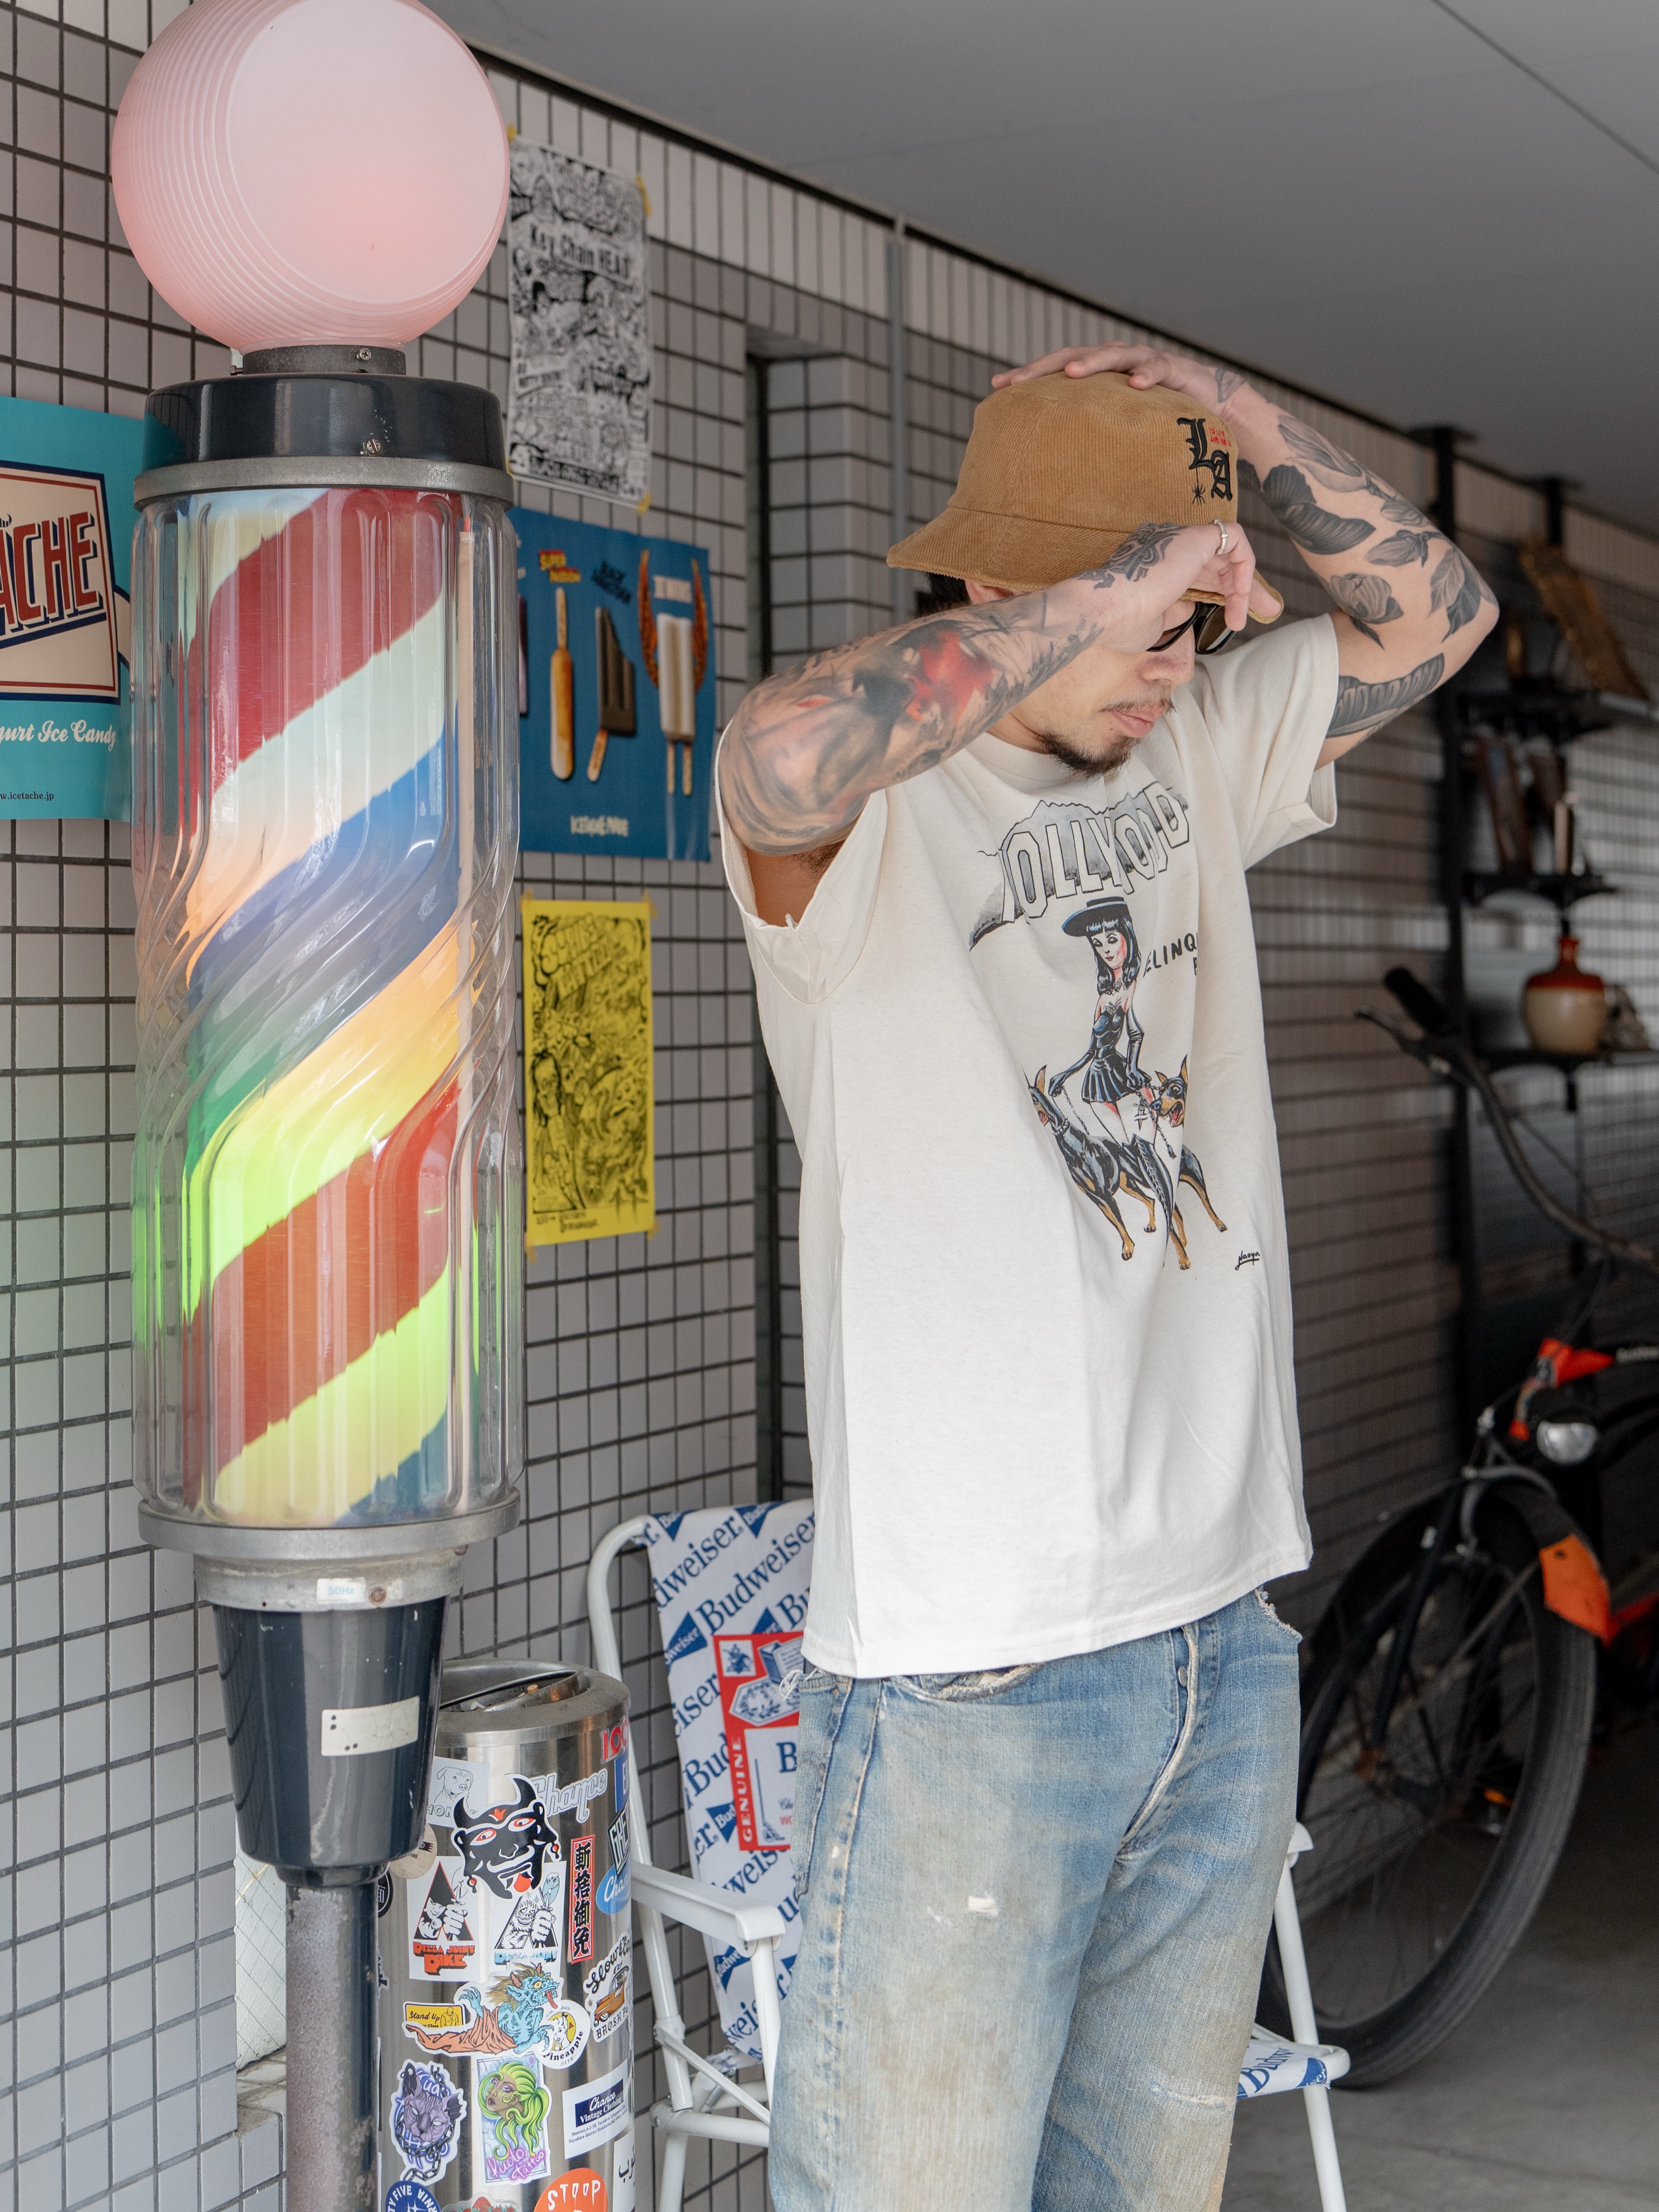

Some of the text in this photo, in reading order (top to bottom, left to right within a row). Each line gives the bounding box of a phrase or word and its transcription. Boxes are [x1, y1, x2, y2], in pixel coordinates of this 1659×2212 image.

[38, 720, 68, 742] Ice
[71, 720, 116, 751] Candy
[328, 1586, 354, 1595] 50Hz
[731, 1737, 753, 1843] GENUINE
[574, 1841, 591, 1957] 斬捨御免
[413, 1941, 475, 1957] PIZZA JOINT
[409, 2011, 440, 2024] Stand Up
[580, 2096, 622, 2123] Vintage Clothing
[589, 2092, 616, 2112] Chance
[569, 2135, 585, 2144] Toyohira
[392, 2185, 413, 2201] FIVE
[548, 2180, 601, 2211] STOOP
